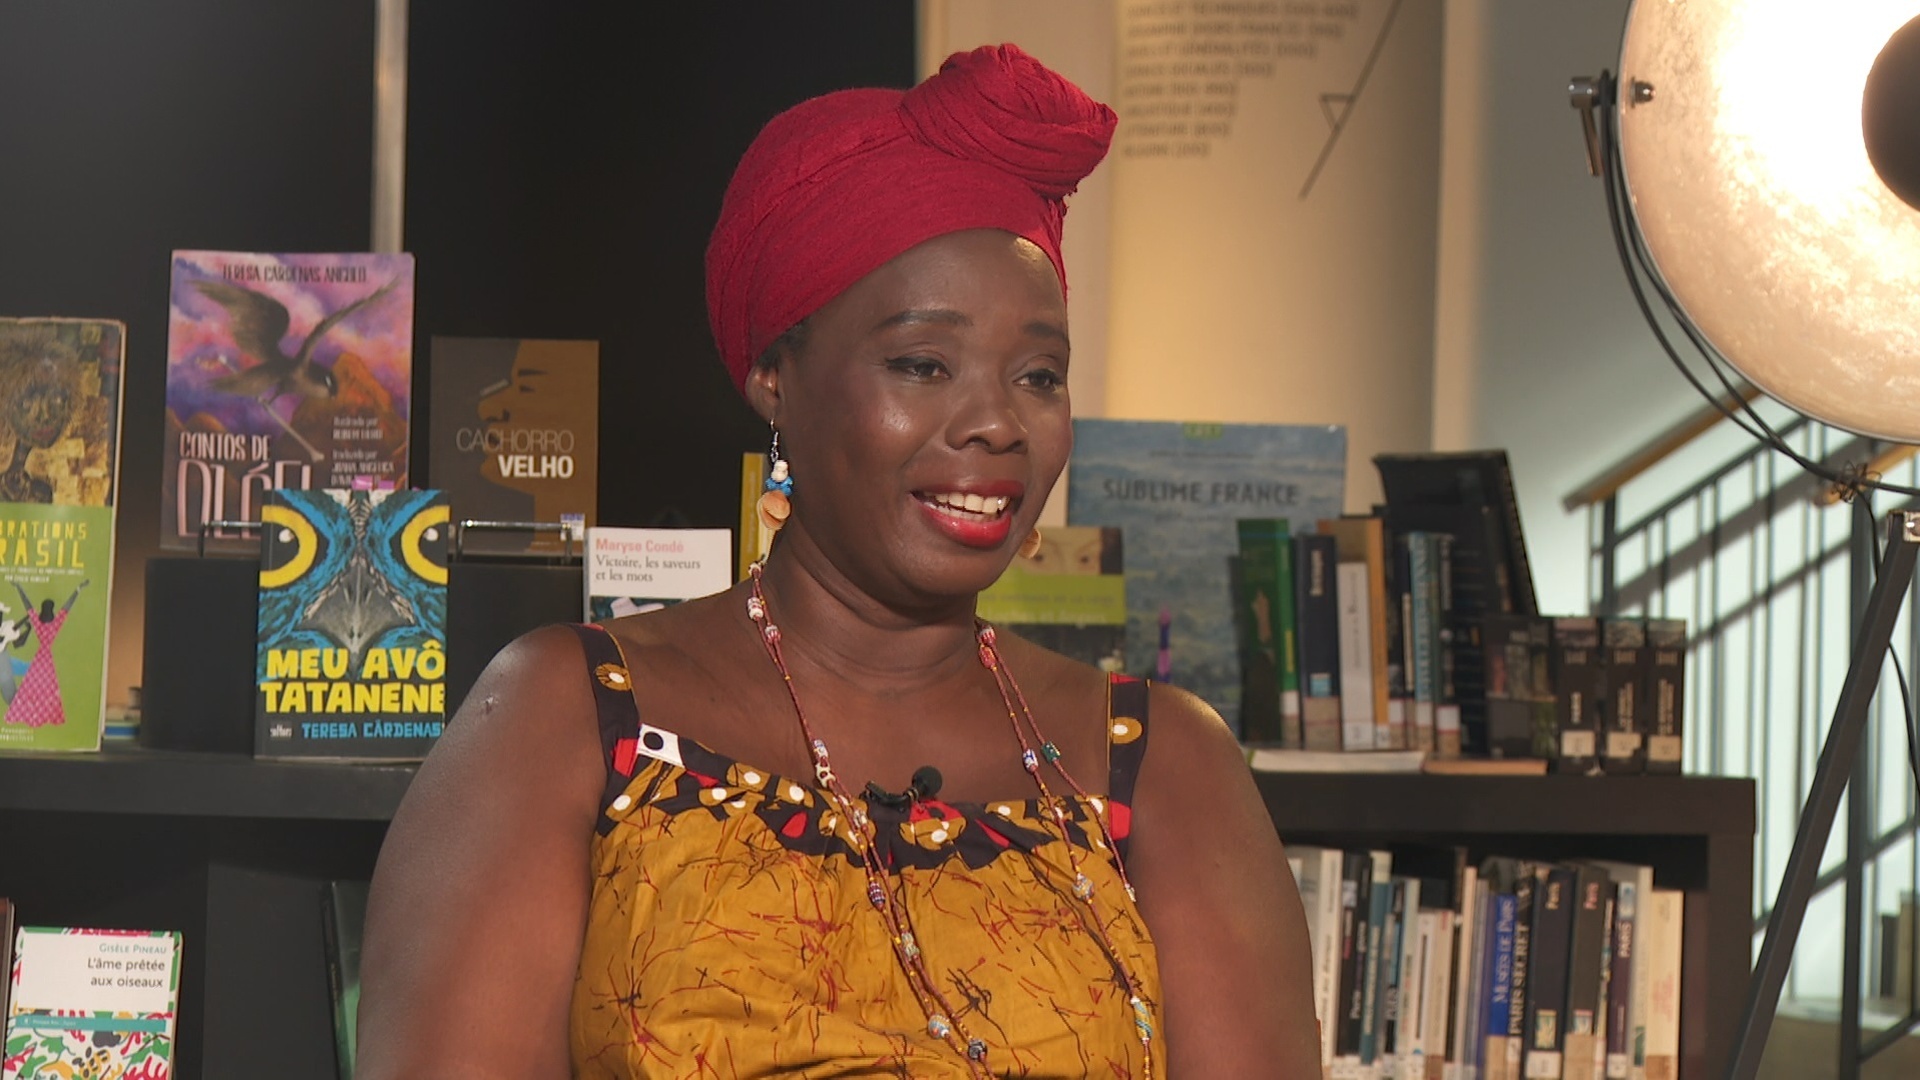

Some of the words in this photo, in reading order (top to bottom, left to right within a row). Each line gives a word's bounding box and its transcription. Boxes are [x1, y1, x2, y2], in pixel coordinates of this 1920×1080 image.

[180, 431, 246, 461] CONTOS
[252, 434, 271, 461] DE
[456, 428, 574, 452] CACHORRO
[498, 455, 574, 478] VELHO
[1103, 478, 1201, 501] SUBLIME
[1210, 481, 1299, 504] FRANCE
[596, 539, 642, 553] Maryse
[645, 540, 684, 553] Condé
[596, 555, 642, 568] Victoire,
[646, 557, 659, 569] les
[663, 560, 701, 569] saveurs
[596, 571, 606, 580] et
[610, 570, 623, 581] les
[626, 574, 653, 582] mots
[266, 648, 349, 679] MEU
[361, 639, 446, 680] AVÔ
[260, 681, 445, 713] TATANENE
[302, 722, 357, 739] TERESA
[363, 719, 441, 739] CÁRDENAS
[133, 944, 167, 954] PINEAU
[1618, 921, 1632, 957] PARIS
[126, 959, 165, 972] prêtée
[1512, 923, 1528, 986] SECRET
[91, 976, 113, 987] aux
[117, 975, 163, 988] oiseaux
[1509, 988, 1524, 1033] PARIS
